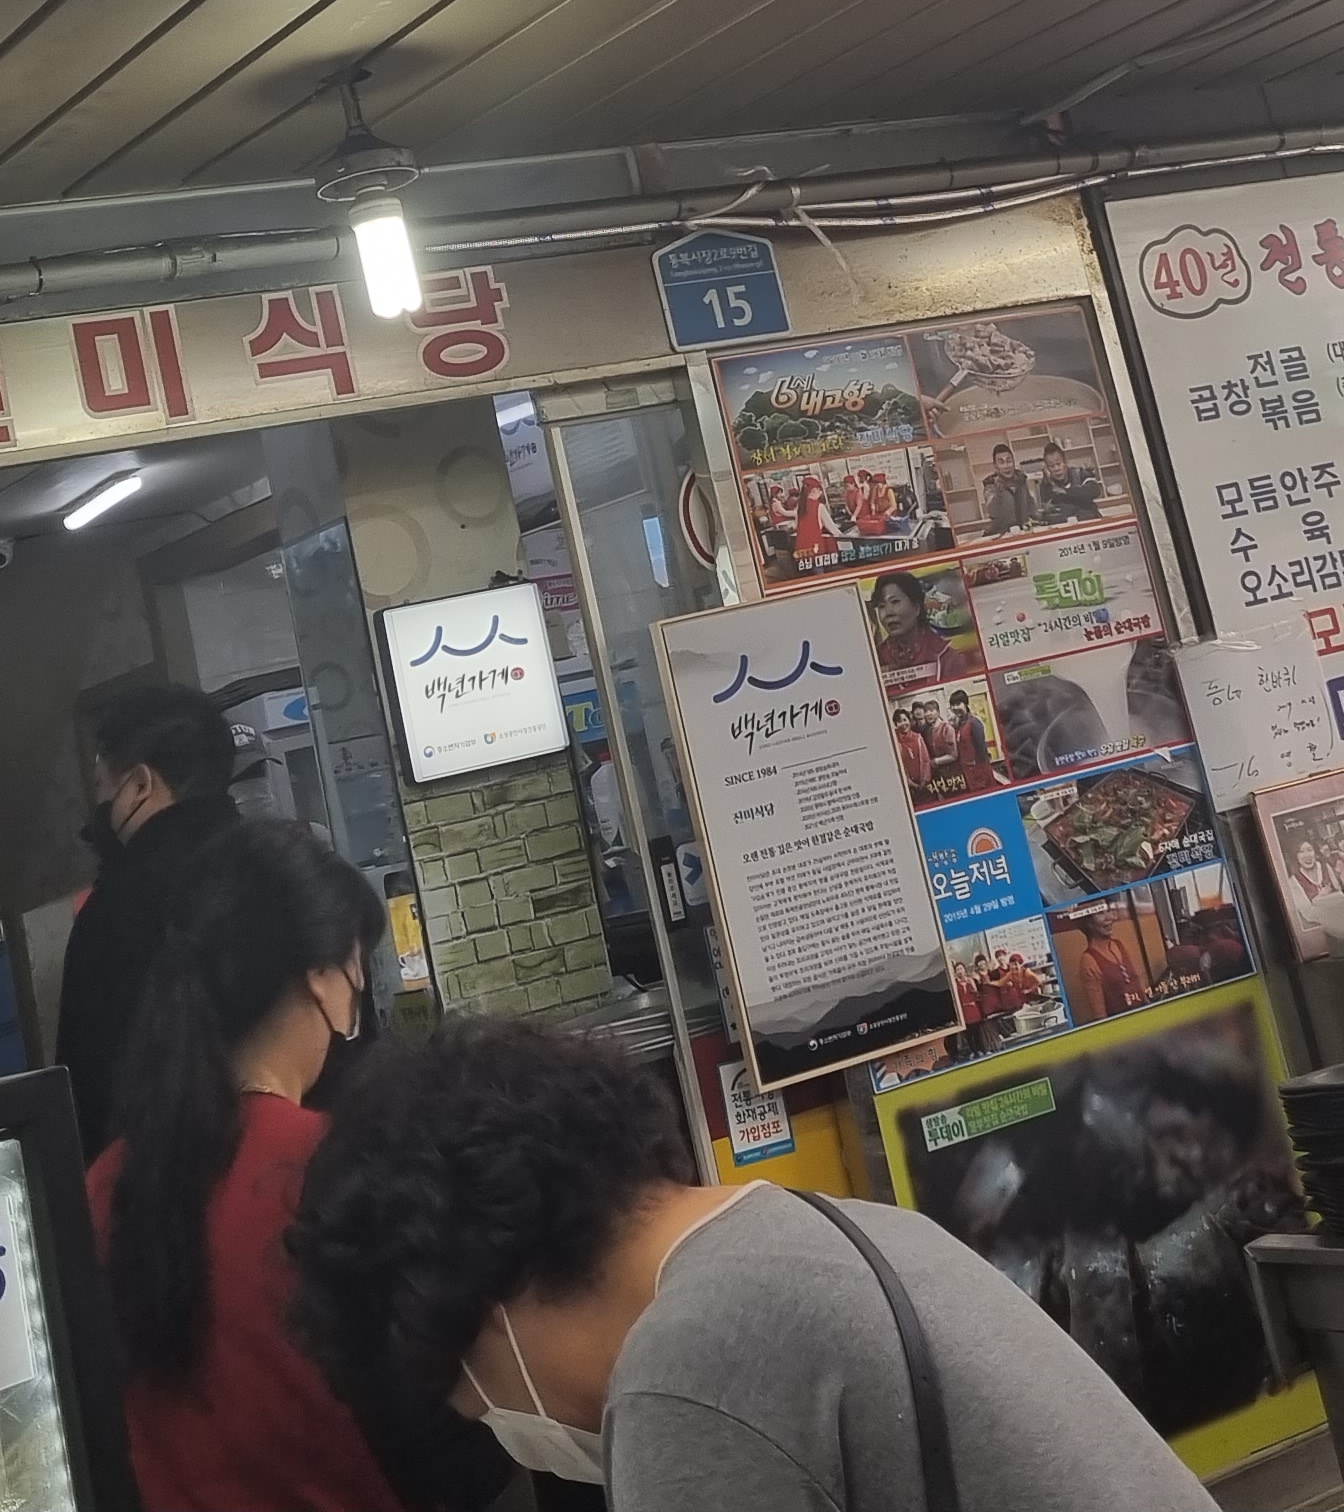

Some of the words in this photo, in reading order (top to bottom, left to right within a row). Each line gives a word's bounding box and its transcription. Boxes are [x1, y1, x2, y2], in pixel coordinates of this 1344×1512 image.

[1153, 243, 1240, 300] 40년
[702, 285, 753, 329] 15
[1247, 345, 1311, 389] 전골
[1188, 378, 1254, 422] 곱창
[1259, 388, 1323, 431] 볶음
[1215, 461, 1342, 521] 모듬안주
[424, 665, 509, 715] 백년가게
[730, 697, 824, 757] 백년가게
[724, 770, 755, 787] SINCE
[756, 764, 779, 781] 1984
[732, 802, 776, 825] 진미식당
[931, 854, 1013, 902] 오늘저녁
[734, 1102, 779, 1125] 화재공제
[738, 1120, 784, 1145] 가입점포
[928, 1119, 966, 1148] 투데이
